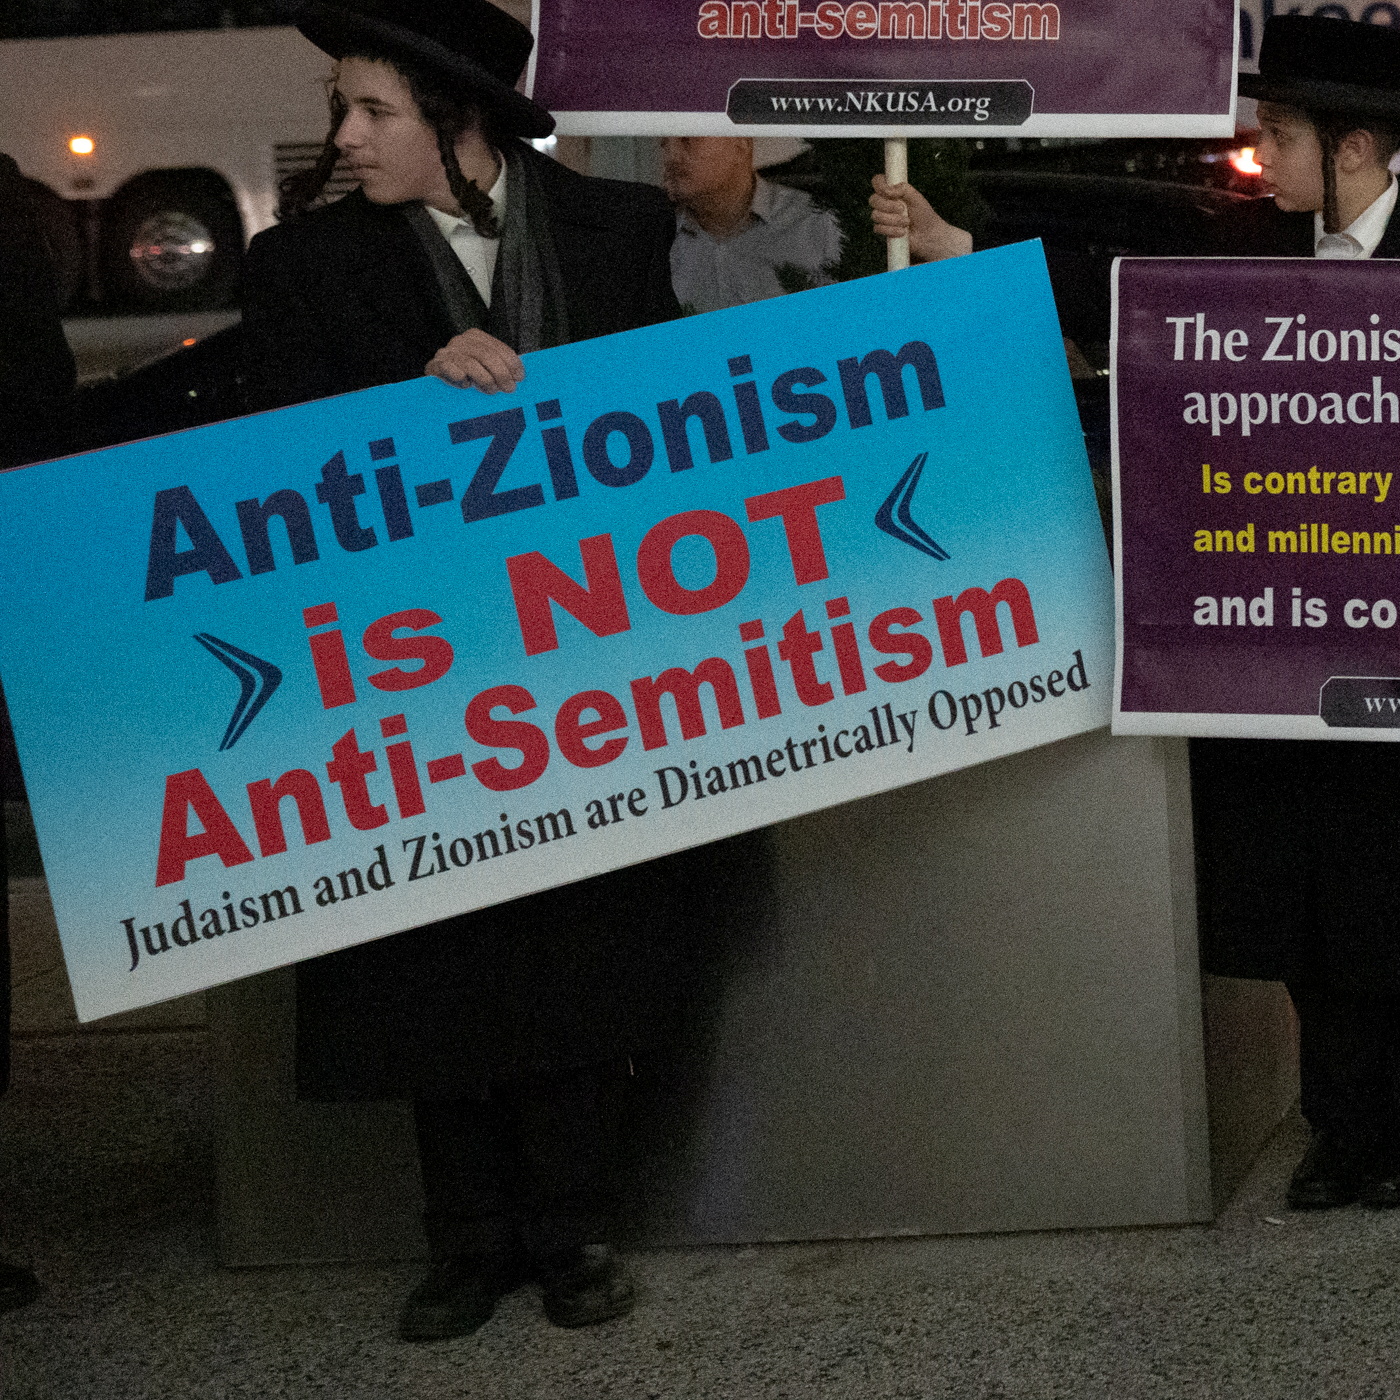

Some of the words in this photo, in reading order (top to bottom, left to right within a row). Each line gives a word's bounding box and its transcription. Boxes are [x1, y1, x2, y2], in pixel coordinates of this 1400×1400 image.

[771, 91, 991, 122] www.NKUSA.org
[1166, 313, 1249, 361] The
[1182, 377, 1399, 436] approach
[144, 340, 947, 602] Anti-Zionism
[1202, 464, 1232, 494] Is
[1244, 466, 1392, 502] contrary
[1193, 524, 1256, 552] and
[303, 601, 455, 709] is
[505, 476, 847, 658] NOT
[1193, 588, 1274, 627] and
[1291, 588, 1328, 628] is
[155, 576, 1040, 888] Anti-Semitism
[120, 882, 304, 971] Judaism
[314, 843, 395, 910] and
[403, 806, 577, 882] Zionism
[586, 784, 647, 831] are
[657, 700, 926, 810] Diametrically
[928, 650, 1091, 739] Opposed
